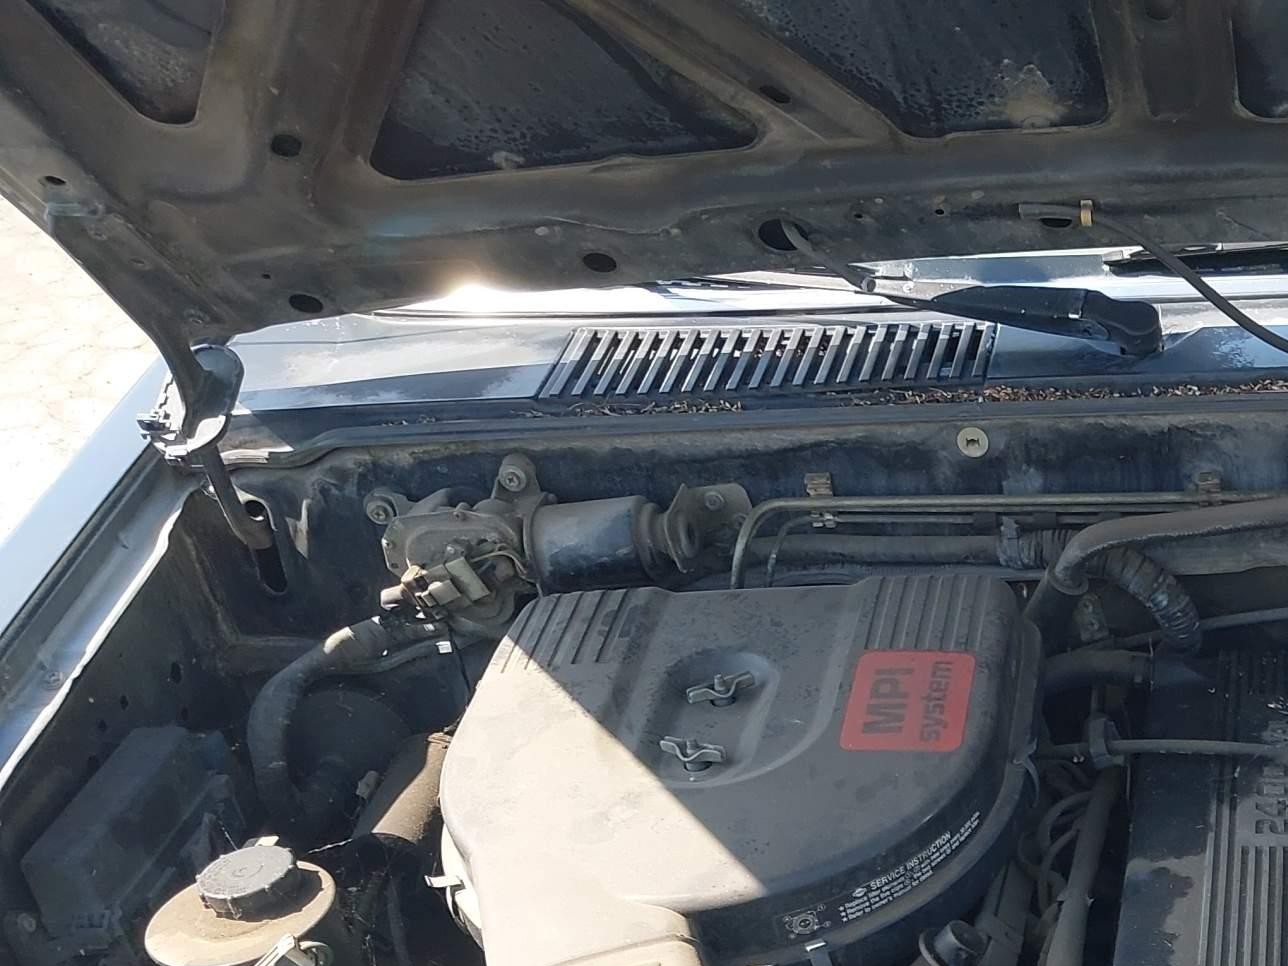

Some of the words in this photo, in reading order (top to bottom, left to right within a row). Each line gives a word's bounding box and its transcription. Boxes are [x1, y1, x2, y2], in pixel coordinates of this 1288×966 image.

[861, 667, 915, 734] MPI
[919, 660, 953, 742] system
[870, 865, 905, 890] SERVICE
[906, 830, 951, 870] INSTRUCTION
